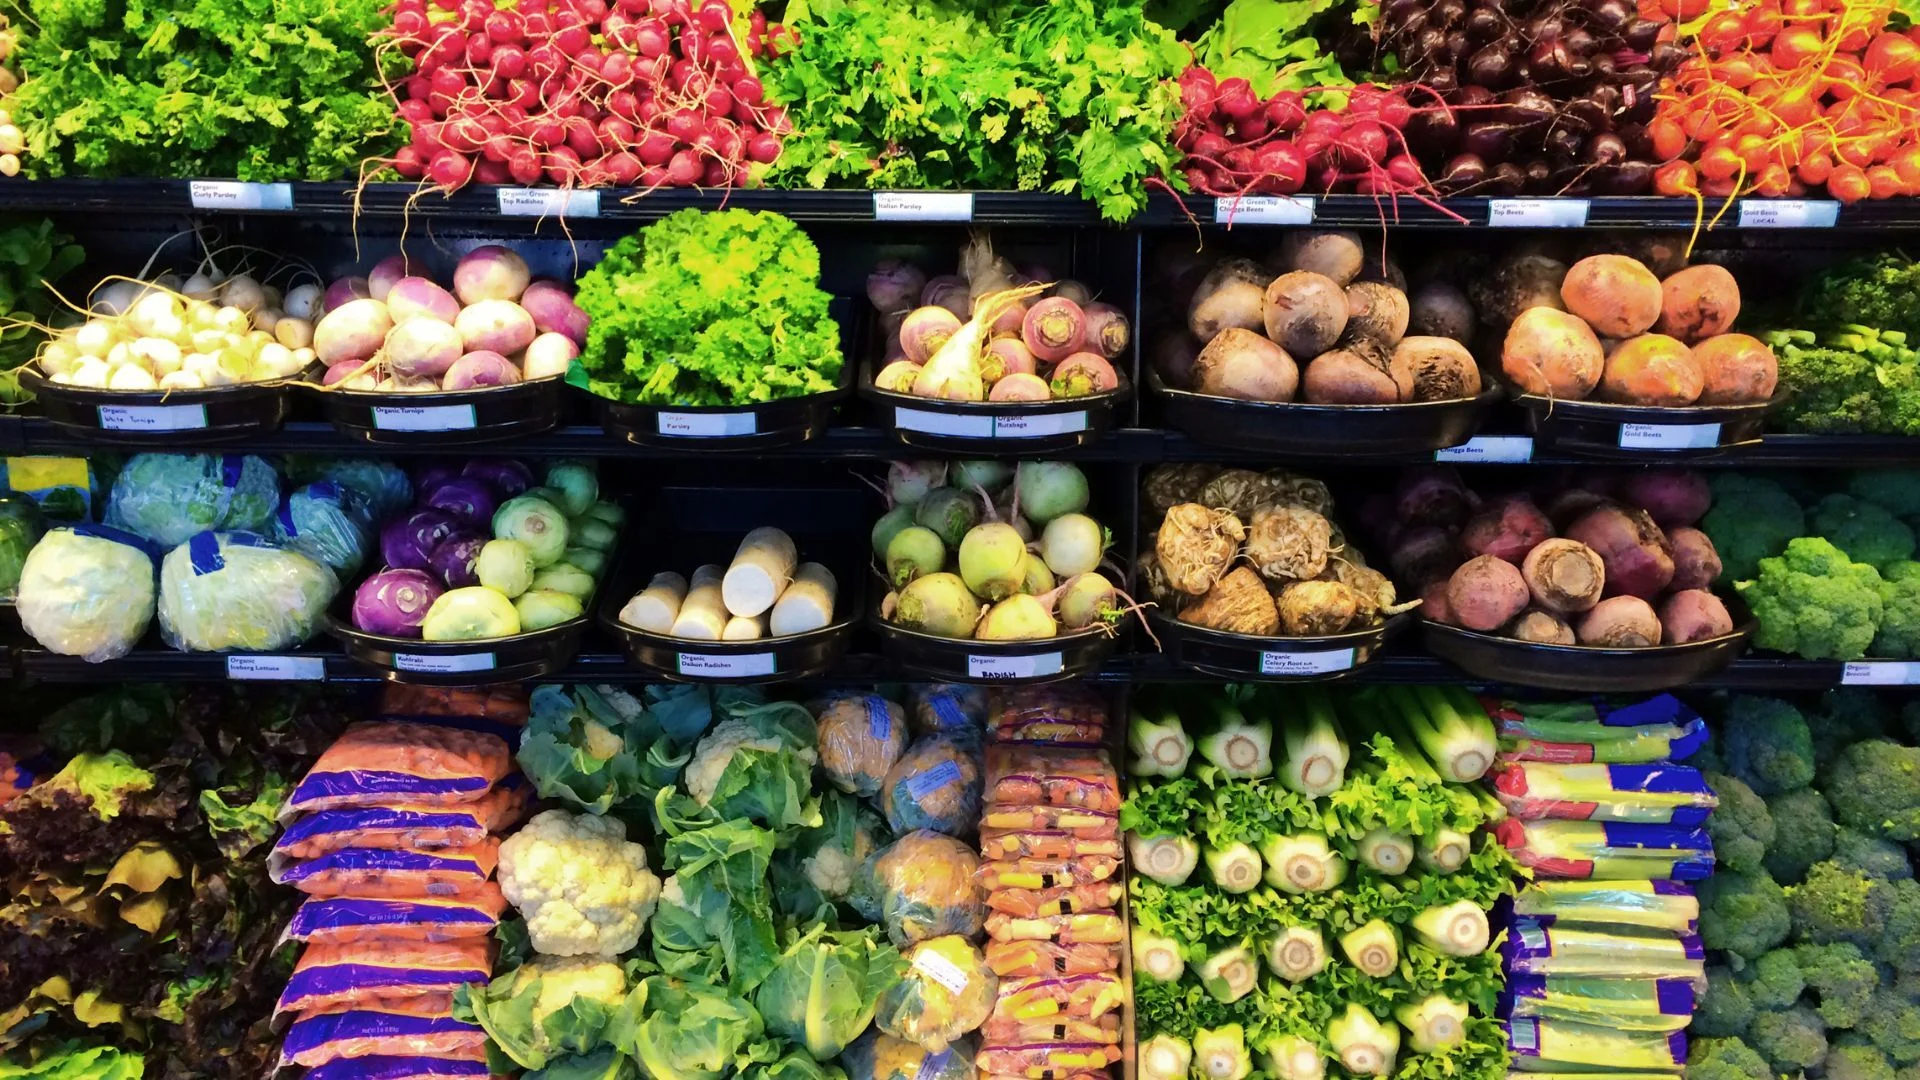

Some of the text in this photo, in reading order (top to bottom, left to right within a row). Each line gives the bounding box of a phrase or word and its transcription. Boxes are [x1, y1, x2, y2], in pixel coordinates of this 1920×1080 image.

[193, 191, 237, 199] Curly Parsley
[502, 190, 528, 198] Organic
[503, 198, 514, 206] Top
[1267, 198, 1278, 206] Top
[899, 203, 922, 211] Parsley
[1494, 209, 1505, 217] Top
[102, 407, 128, 415] Organic
[376, 407, 425, 415] Organic Turnips
[997, 414, 1023, 422] Organic
[666, 423, 690, 431] Parsley
[1625, 423, 1653, 431] Organic
[397, 655, 424, 663] Kohlrabi
[681, 654, 705, 662] Organic
[970, 657, 996, 665] Organic
[1846, 664, 1871, 672] Organic
